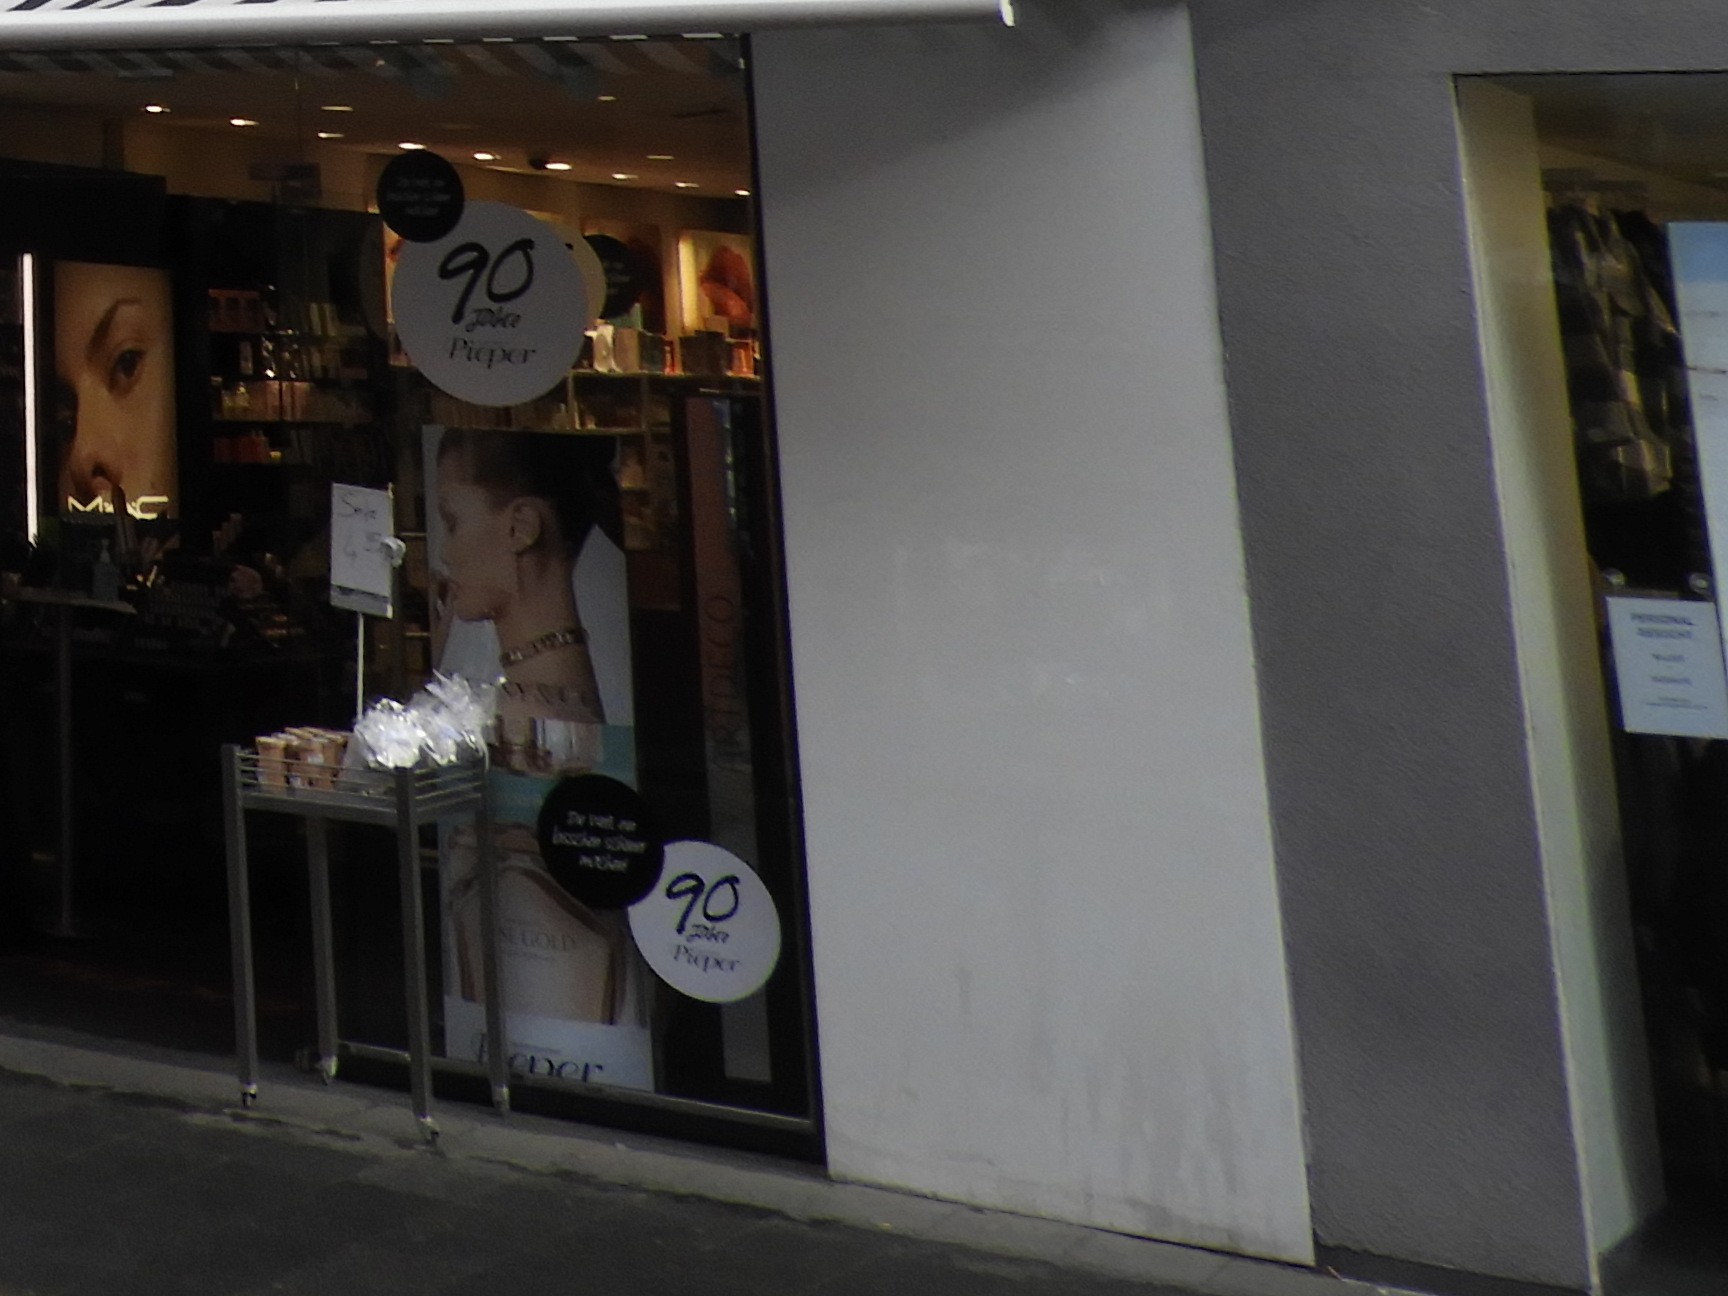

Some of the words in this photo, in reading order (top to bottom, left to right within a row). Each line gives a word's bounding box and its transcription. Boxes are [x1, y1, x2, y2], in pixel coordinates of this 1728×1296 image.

[438, 236, 536, 325] 90
[448, 336, 537, 370] Pieper
[704, 595, 749, 773] ARTDECO
[665, 872, 741, 935] 90
[673, 944, 742, 974] Pieper
[470, 1030, 605, 1085] Peper
